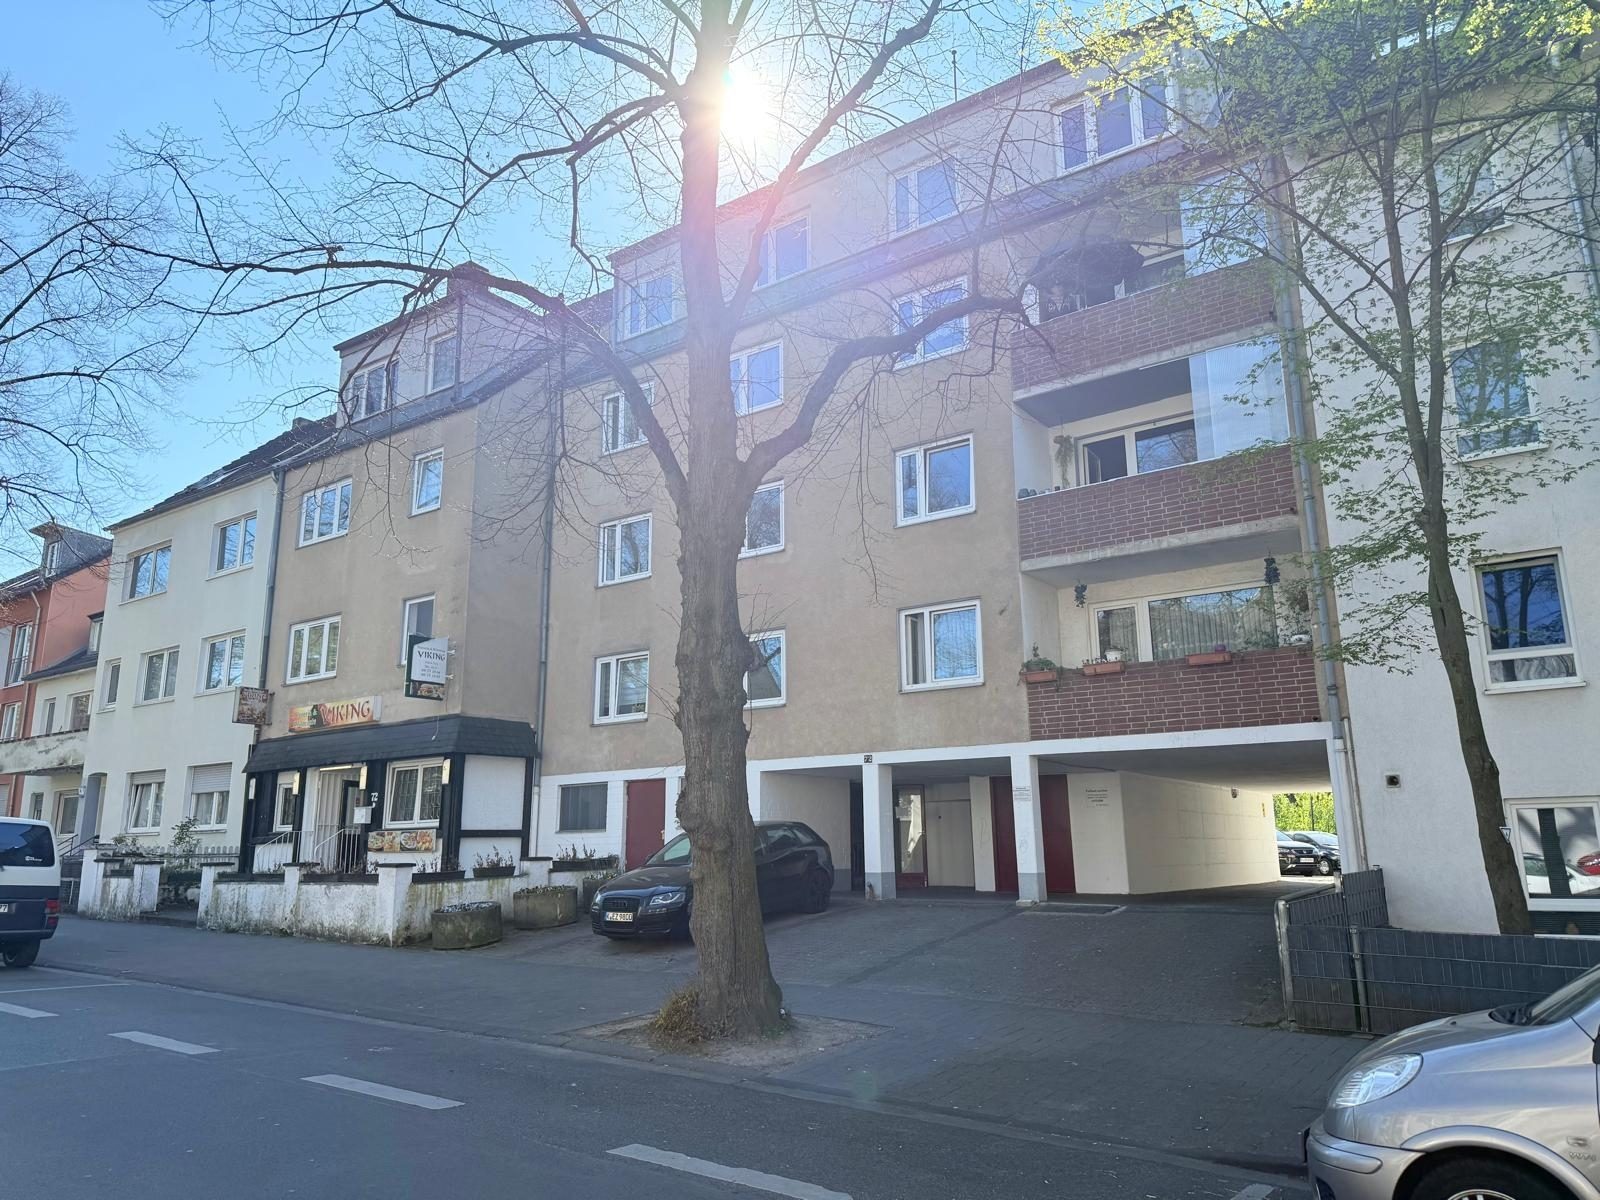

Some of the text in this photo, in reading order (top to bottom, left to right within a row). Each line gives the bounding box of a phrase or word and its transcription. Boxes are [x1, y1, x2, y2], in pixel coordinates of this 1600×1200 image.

[417, 650, 446, 661] VIKING
[319, 700, 370, 726] VIKING
[371, 792, 379, 802] 72
